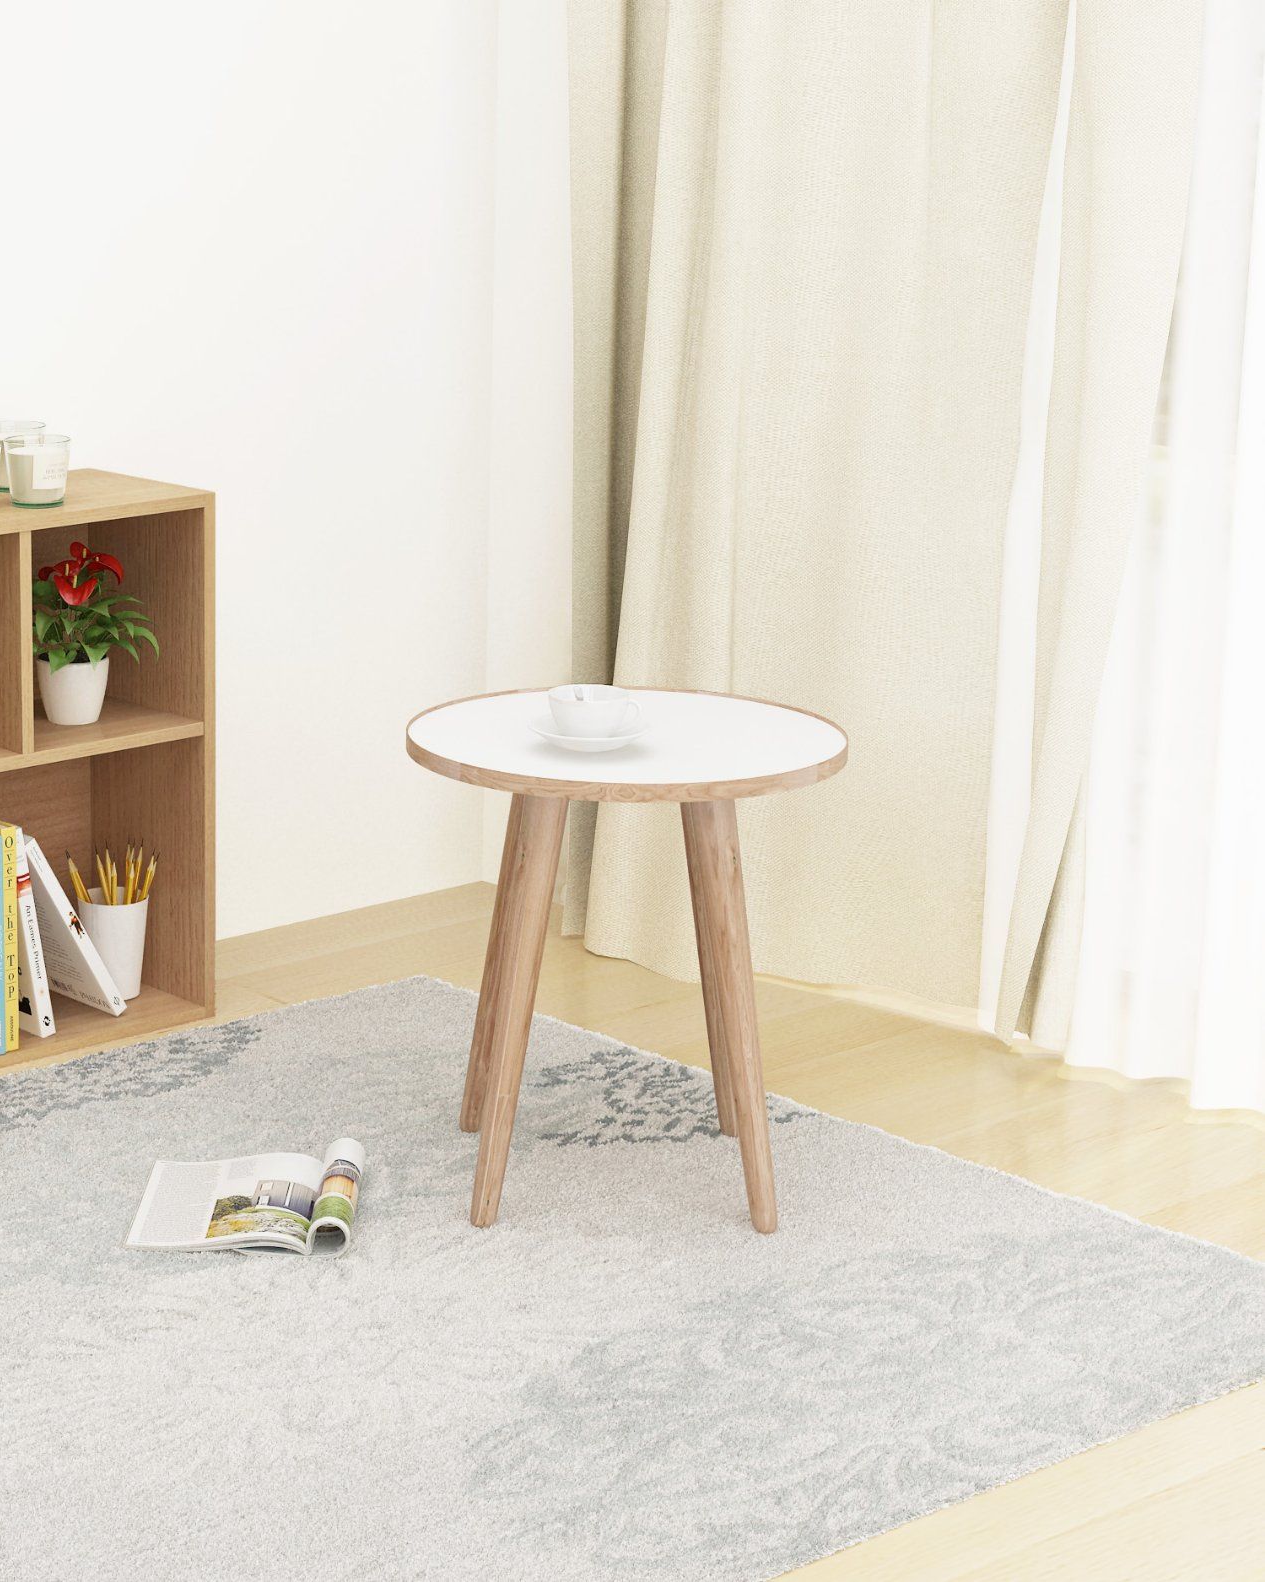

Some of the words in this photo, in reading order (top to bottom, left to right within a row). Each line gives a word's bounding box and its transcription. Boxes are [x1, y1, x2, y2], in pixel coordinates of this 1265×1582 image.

[4, 836, 14, 888] Over
[25, 905, 31, 915] An
[27, 920, 36, 949] Eames
[34, 951, 42, 980] Primer
